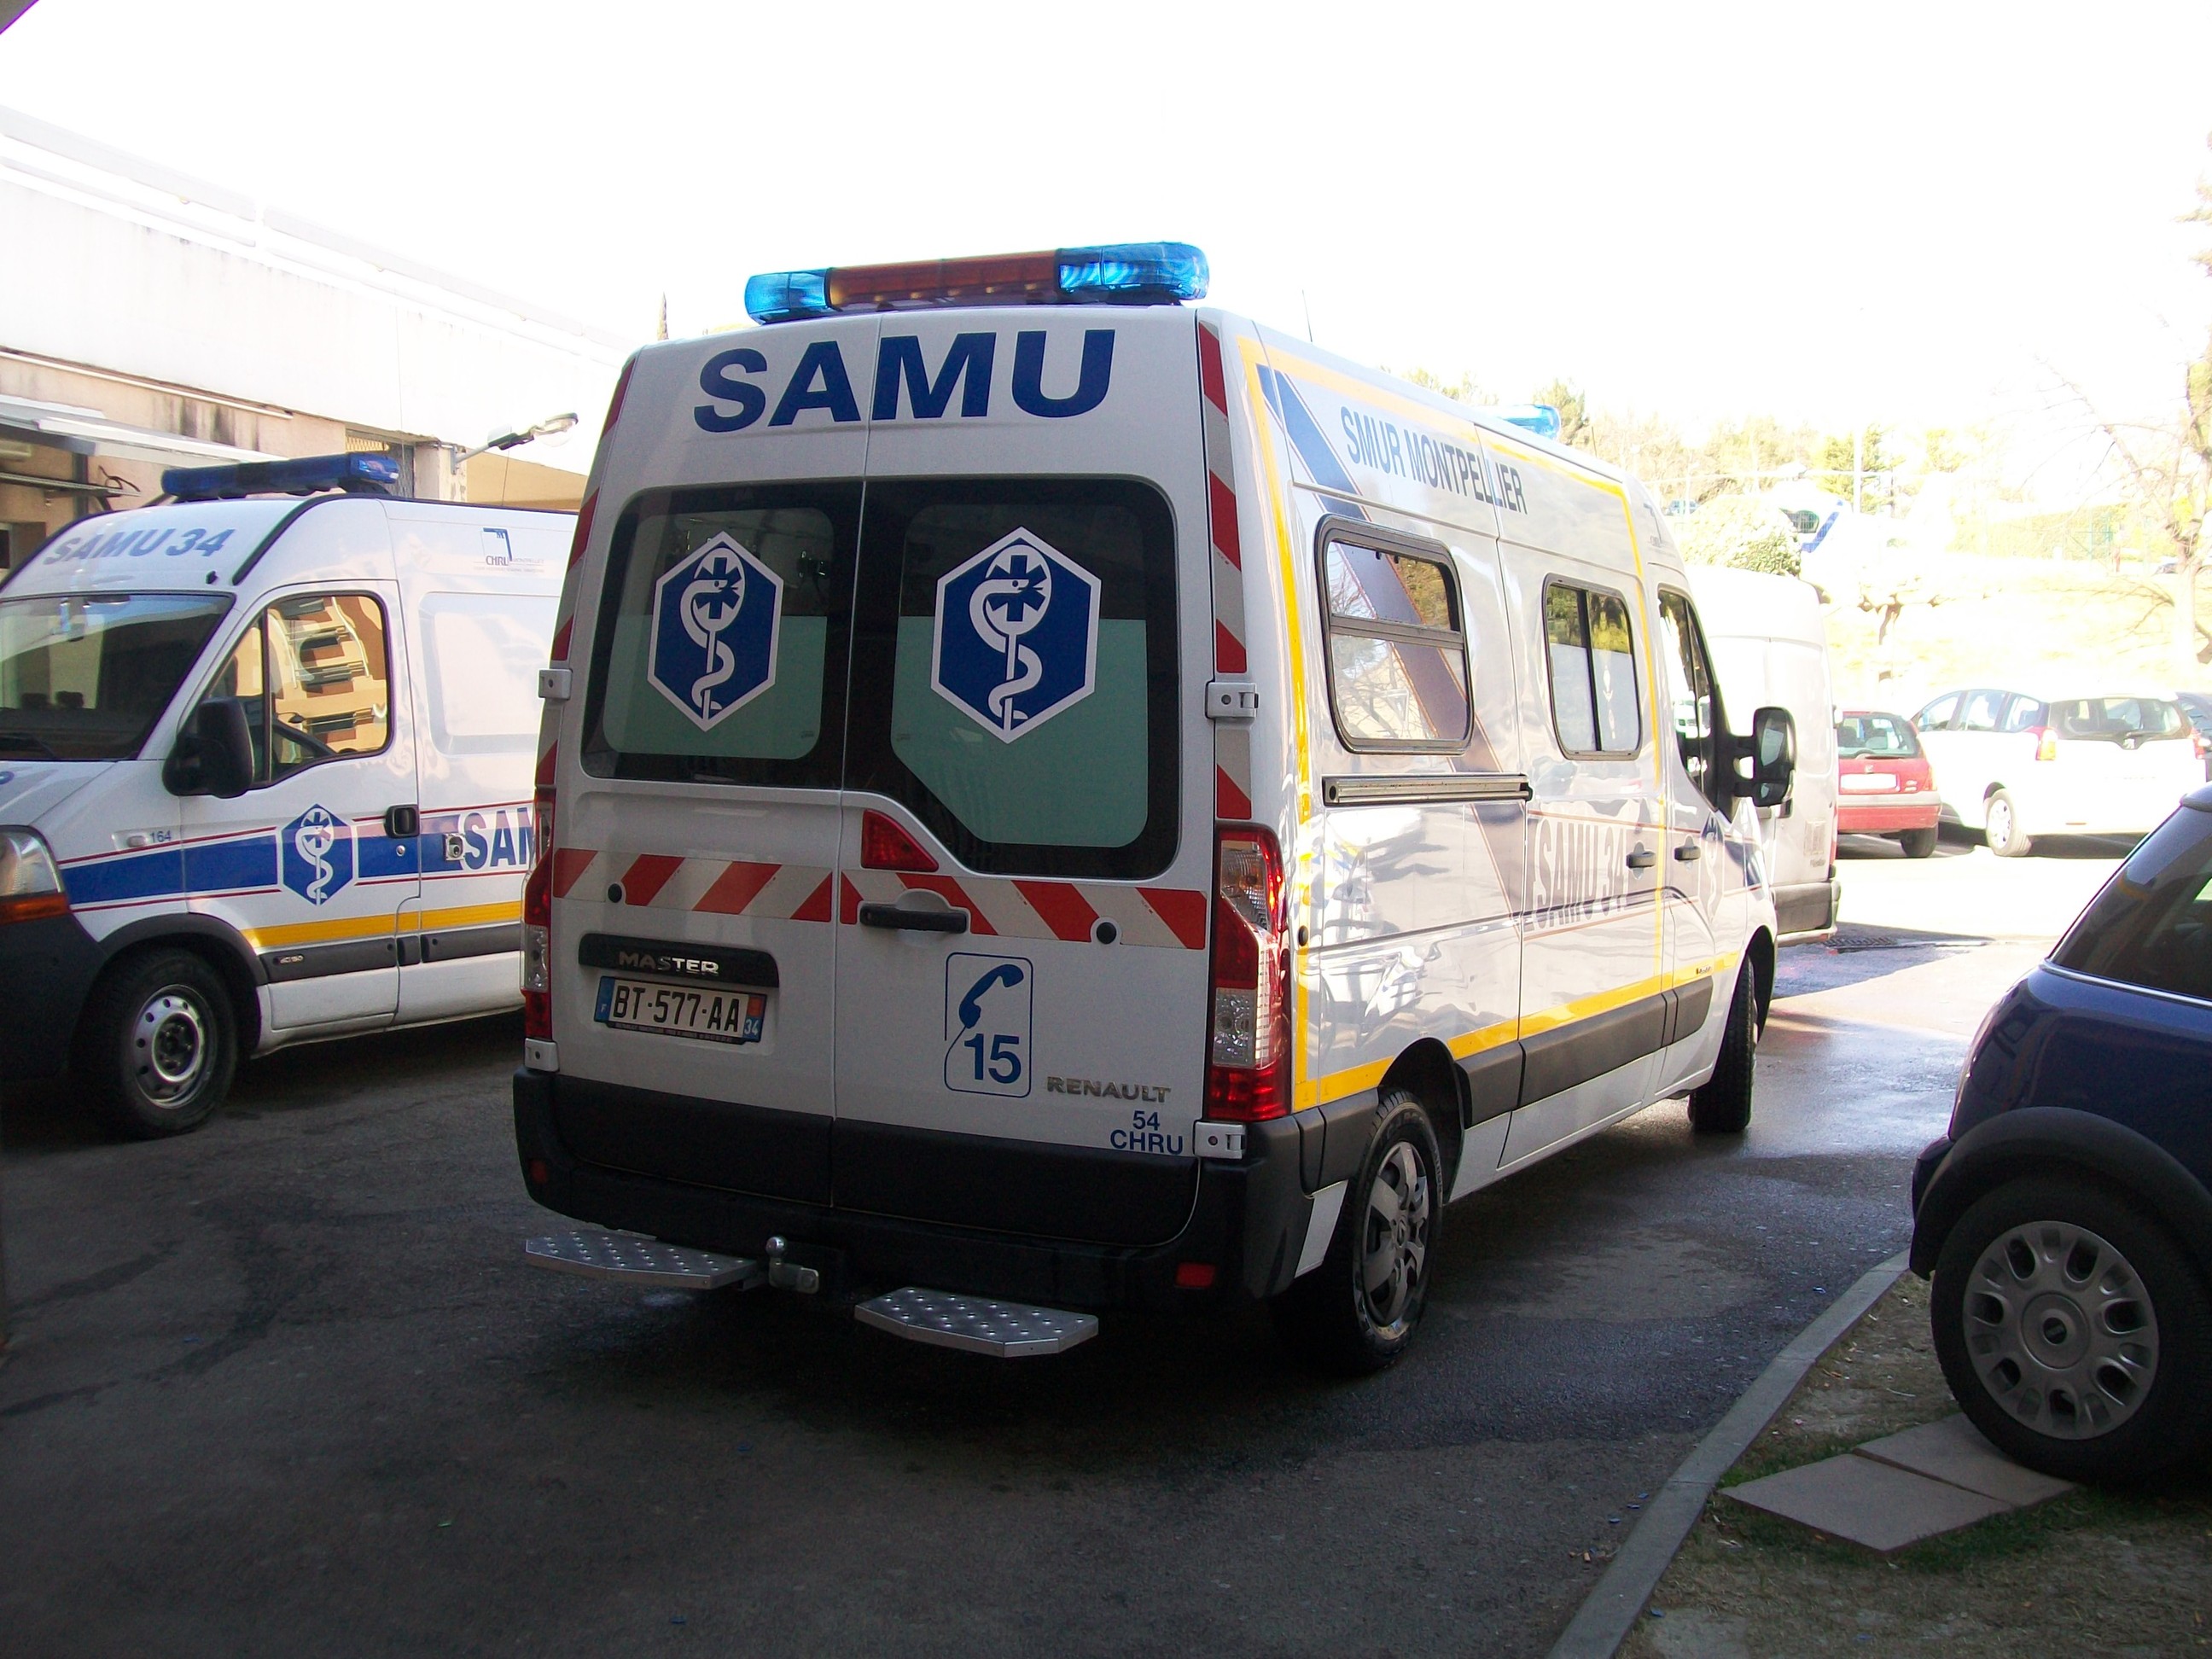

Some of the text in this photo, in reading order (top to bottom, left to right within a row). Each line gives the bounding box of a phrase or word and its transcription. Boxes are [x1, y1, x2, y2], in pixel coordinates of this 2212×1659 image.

[693, 329, 1115, 433] SAMU
[1341, 406, 1528, 515] SMUR MONTPELLIER
[44, 528, 236, 564] SAMU 34
[149, 830, 172, 843] 164
[1537, 819, 1625, 928] SAMU 34
[619, 951, 719, 974] MASTER
[601, 1004, 606, 1013] F
[744, 1019, 759, 1035] 34
[964, 1033, 1021, 1084] 15
[1047, 1076, 1171, 1103] RENAULT
[1132, 1111, 1160, 1131] 54
[1110, 1129, 1183, 1155] CHRU
